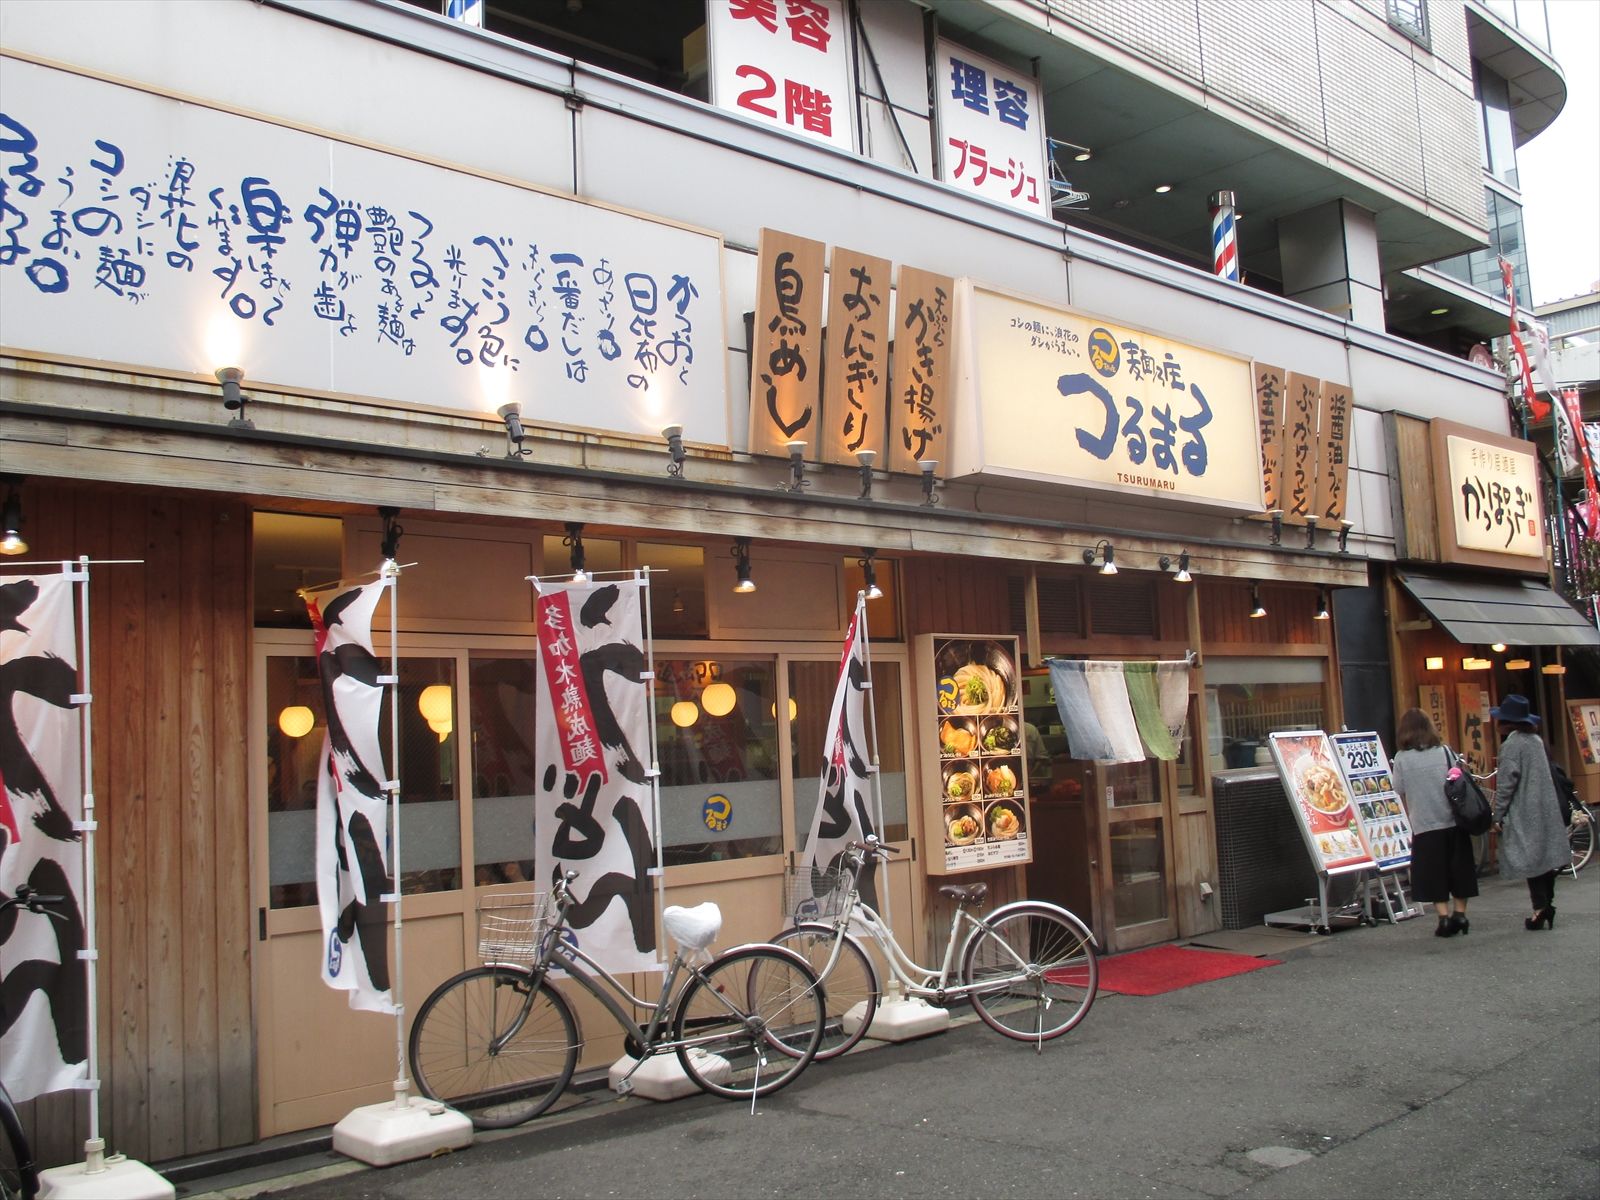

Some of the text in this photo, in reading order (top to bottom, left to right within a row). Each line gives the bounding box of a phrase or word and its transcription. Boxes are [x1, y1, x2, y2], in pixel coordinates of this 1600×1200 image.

[729, 0, 831, 52] 美容
[735, 65, 832, 137] 2階
[950, 57, 1029, 131] 理容
[949, 137, 1039, 205] プラージュ
[550, 253, 589, 383] 一番だしは
[624, 272, 658, 392] 昆布の
[656, 274, 699, 387] かつおと
[760, 251, 813, 439] 鳥めし
[842, 266, 881, 451] おにぎり
[933, 286, 949, 348] 天ぷら
[903, 298, 942, 461] かき揚げ
[1057, 373, 1214, 477] つるまる
[1116, 472, 1176, 491] TSURUMARU
[1461, 476, 1532, 549] かっぽうぎ
